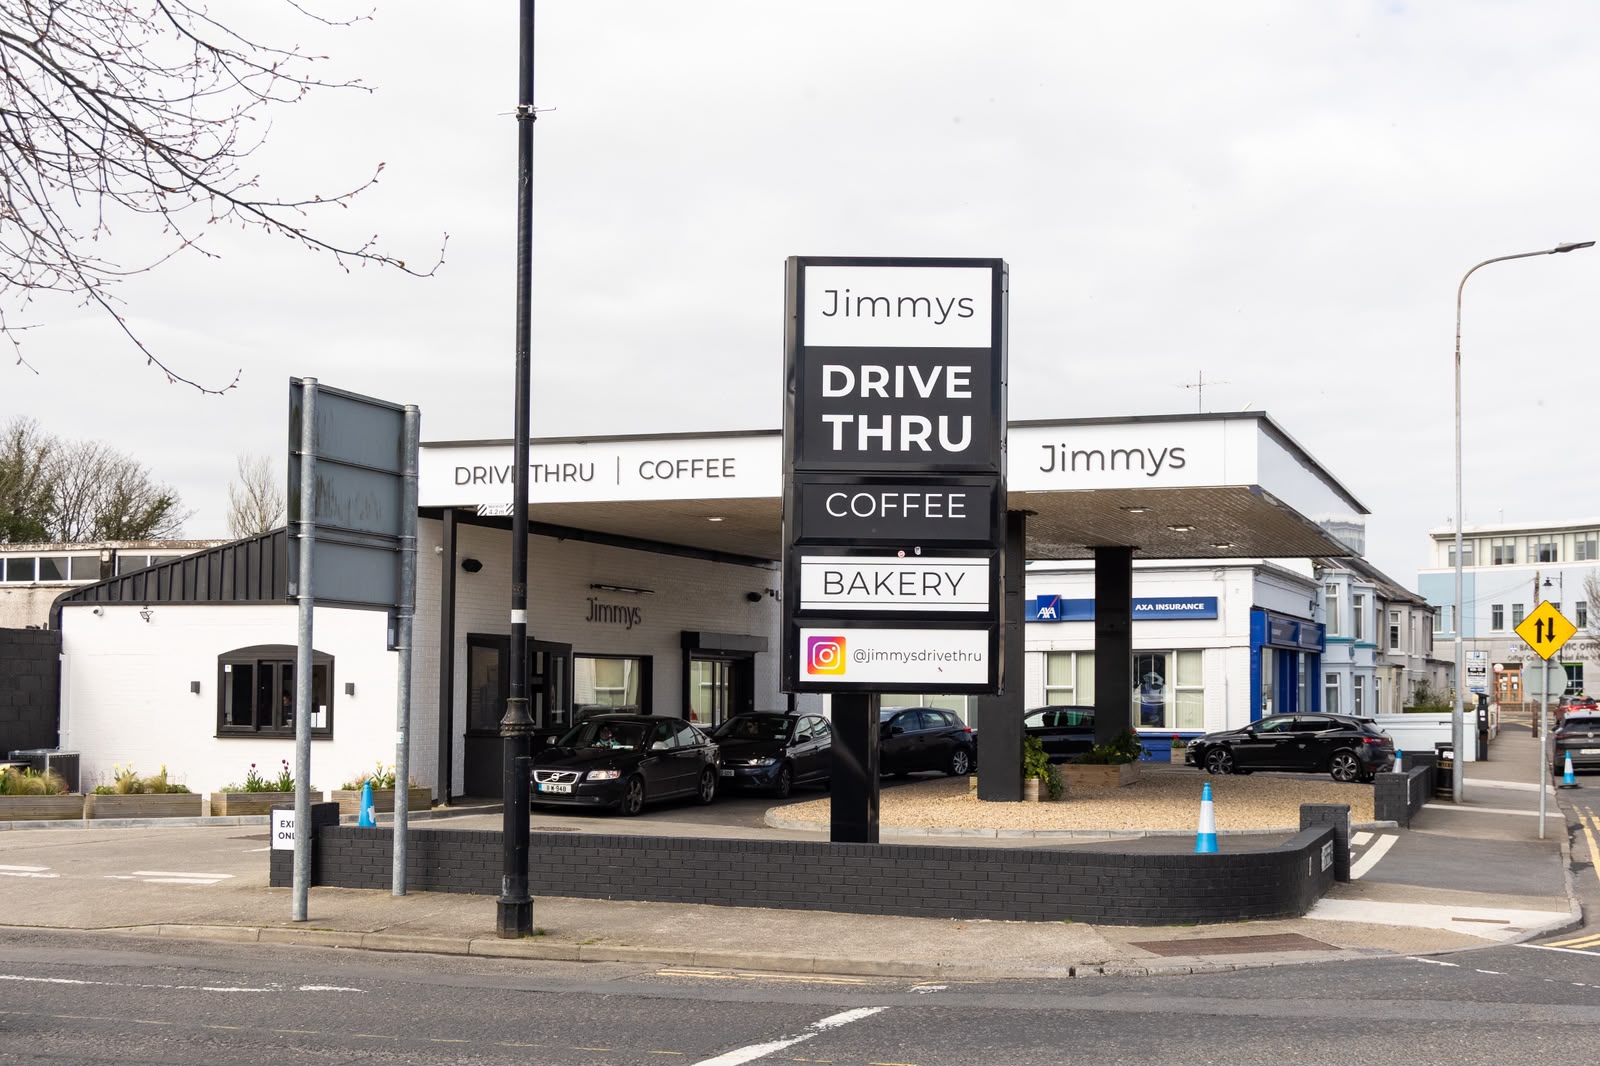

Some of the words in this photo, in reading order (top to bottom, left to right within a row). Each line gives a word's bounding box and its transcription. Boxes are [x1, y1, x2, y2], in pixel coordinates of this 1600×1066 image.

[822, 288, 975, 325] Jimmys
[822, 364, 972, 399] DRIVE
[822, 414, 972, 453] THRU
[529, 462, 595, 483] THRU
[638, 457, 736, 480] COFFEE
[1039, 443, 1187, 477] Jimmys
[825, 492, 967, 519] COFFEE
[823, 570, 966, 597] BAKERY
[585, 596, 642, 630] Jimmys
[1037, 606, 1057, 619] AXA
[1135, 603, 1154, 611] AXA
[1155, 602, 1205, 611] INSURANCE
[853, 648, 982, 664] @jimmysdrivethru
[278, 831, 295, 840] ONL
[280, 820, 294, 828] EXI
